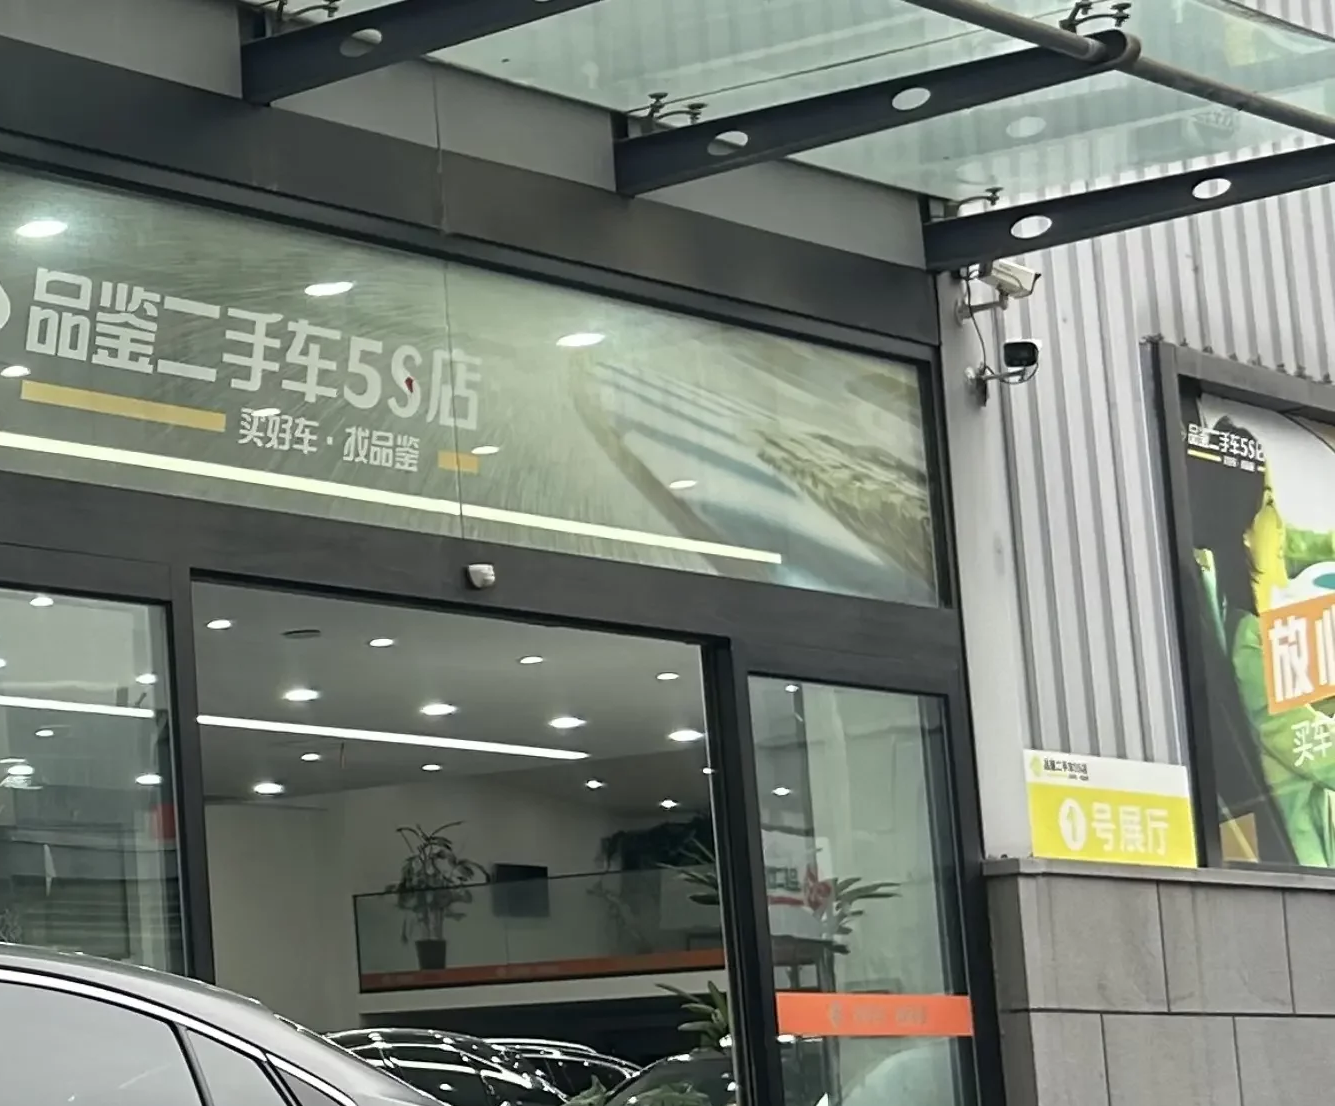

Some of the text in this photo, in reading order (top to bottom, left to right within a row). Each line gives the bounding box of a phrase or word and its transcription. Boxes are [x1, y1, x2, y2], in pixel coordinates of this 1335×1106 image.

[25, 266, 484, 431] 品鉴二手车5S店
